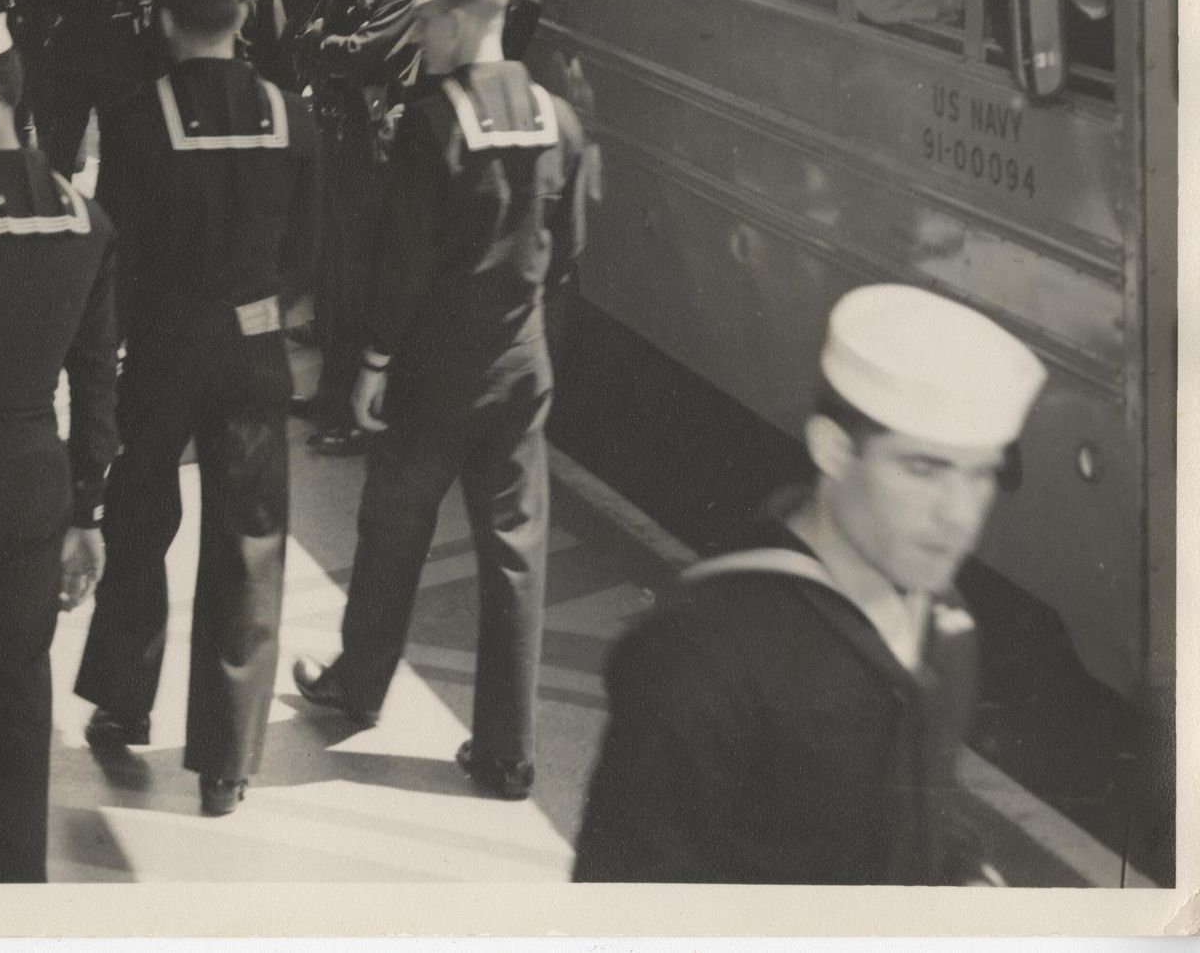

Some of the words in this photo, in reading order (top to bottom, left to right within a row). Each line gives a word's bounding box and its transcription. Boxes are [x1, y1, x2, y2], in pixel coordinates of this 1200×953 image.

[932, 84, 960, 123] US
[970, 96, 1023, 143] NAVY
[922, 126, 1036, 199] 91-00094
